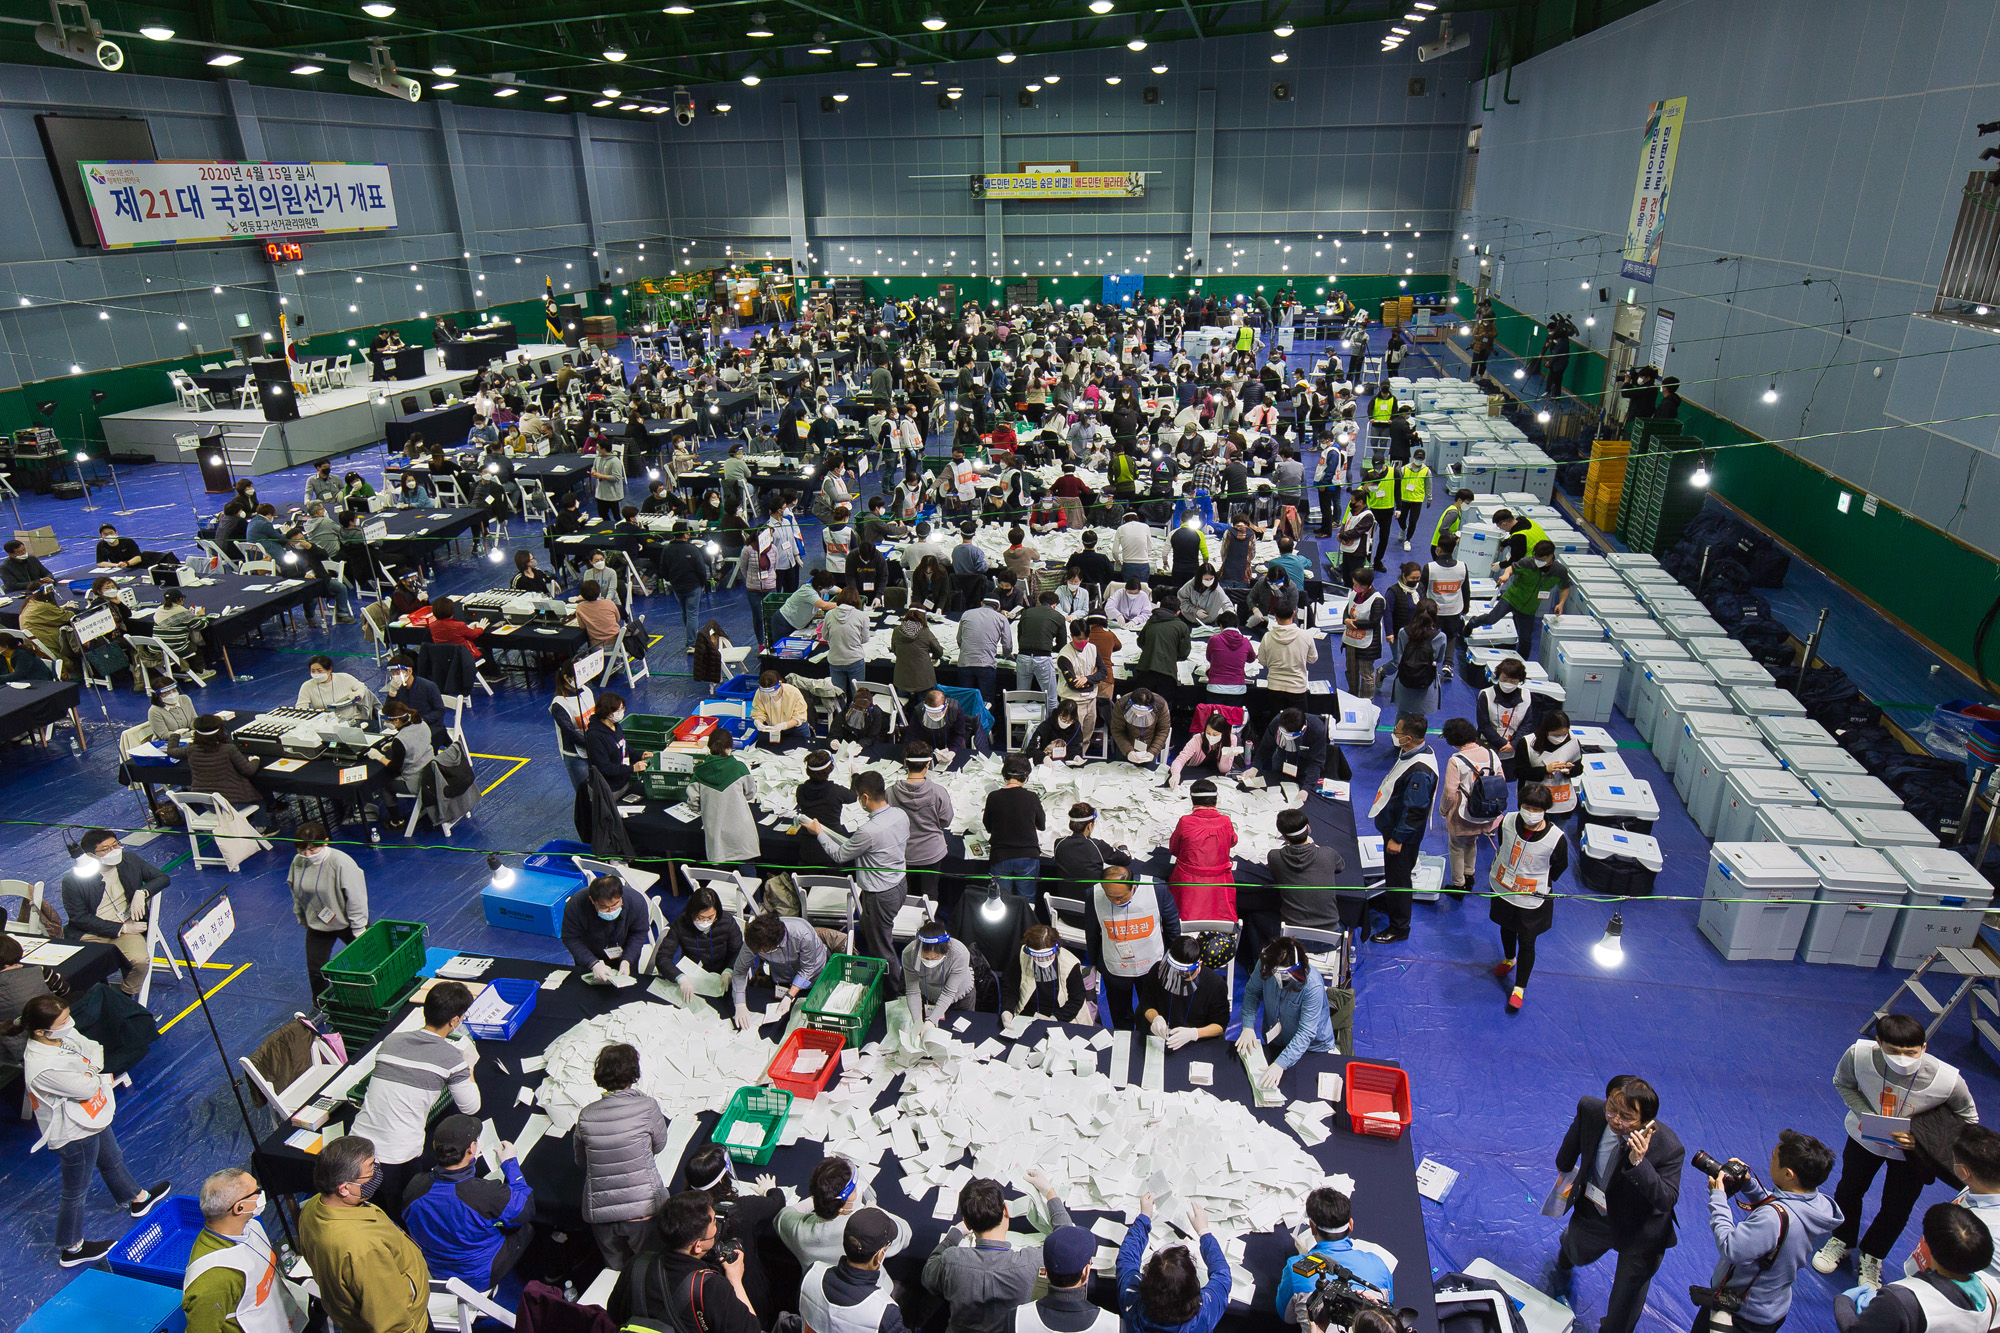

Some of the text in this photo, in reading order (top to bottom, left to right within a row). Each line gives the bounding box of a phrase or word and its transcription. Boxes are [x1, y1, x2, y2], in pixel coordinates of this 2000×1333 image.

[198, 166, 316, 182] 2020년 4월 15일 실시
[983, 175, 1130, 190] 배드민턴 고수되는 숨은 비결!! 배드민턴 필라테스
[109, 182, 386, 223] 제21대 국회의원선거 개표
[240, 217, 319, 233] 영등포구선거관리위원회
[1109, 921, 1150, 937] 개표참관
